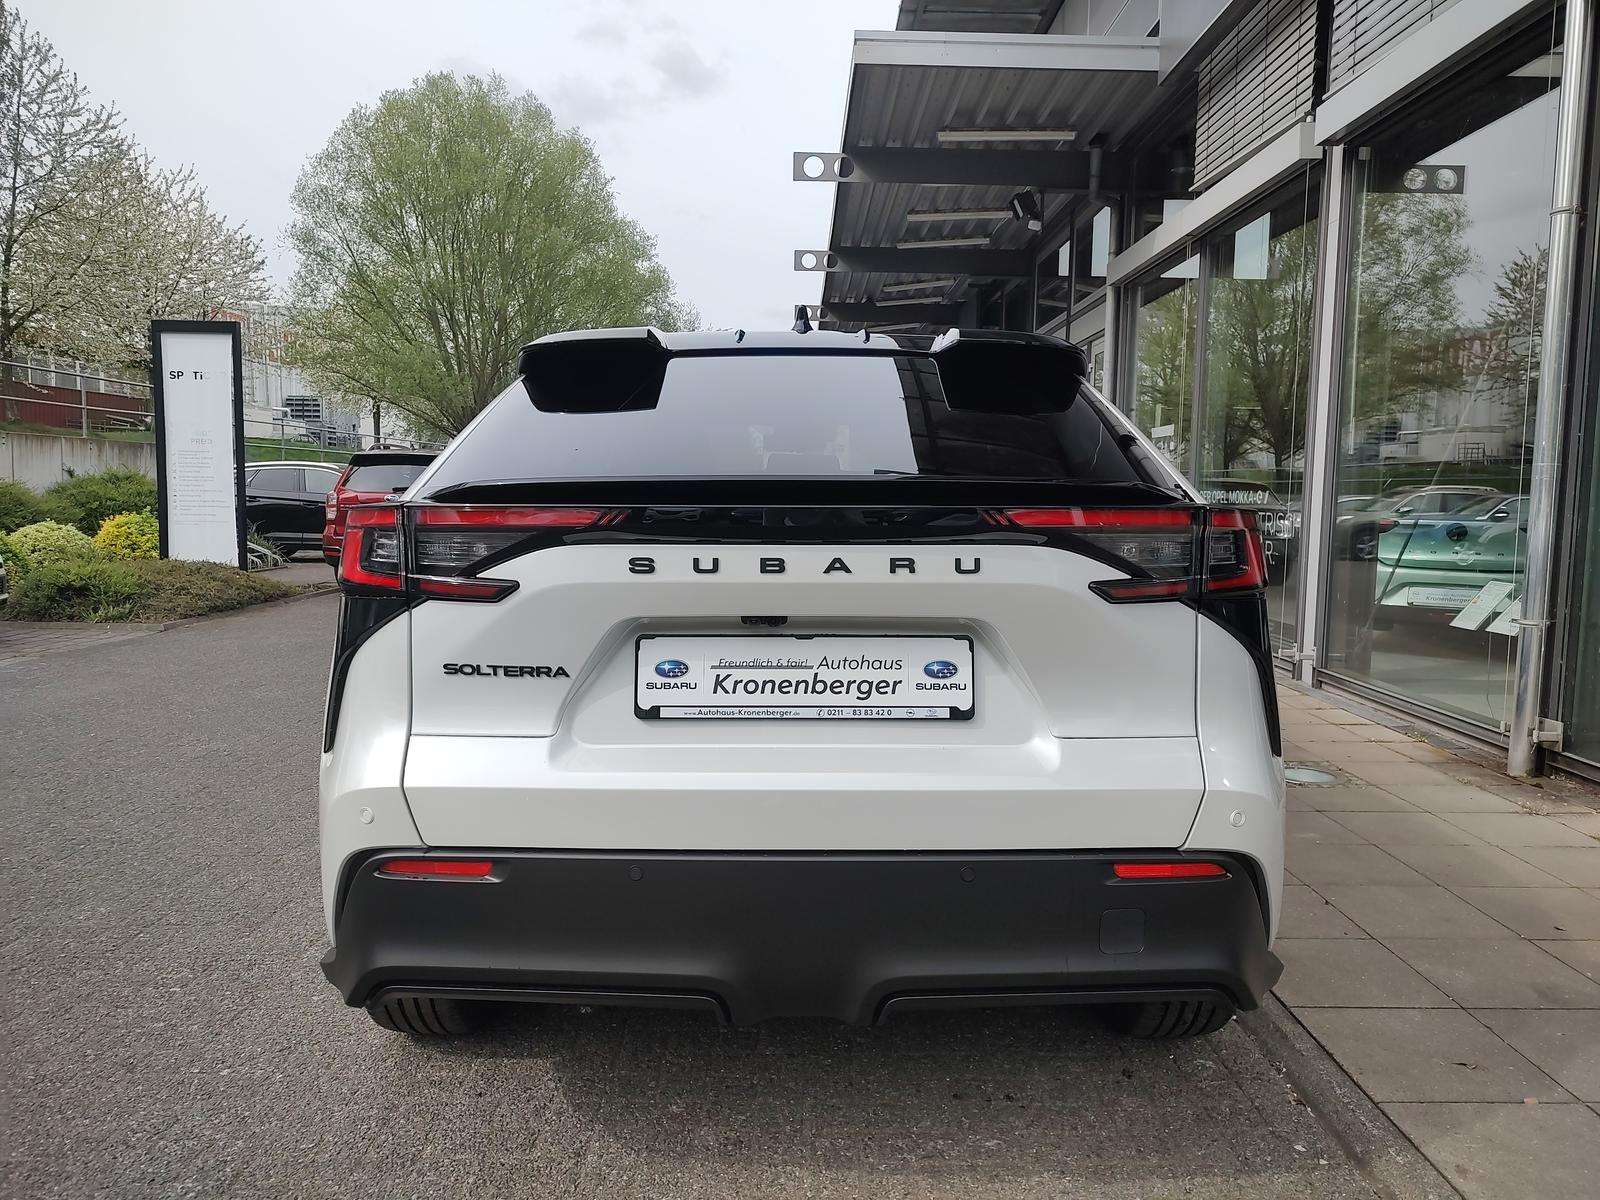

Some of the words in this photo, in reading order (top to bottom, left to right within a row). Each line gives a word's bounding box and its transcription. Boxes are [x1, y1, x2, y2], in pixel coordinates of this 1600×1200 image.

[1211, 490, 1228, 504] OPEL
[628, 557, 981, 574] SUBARU
[718, 658, 773, 668] Freundlich
[776, 659, 784, 668] &
[786, 658, 808, 668] fair!
[816, 654, 903, 670] Autohaus
[442, 663, 570, 678] SOLTERRA
[645, 682, 698, 690] SUBARU
[712, 672, 903, 701] Kronenberger
[915, 682, 967, 691] SUBARU
